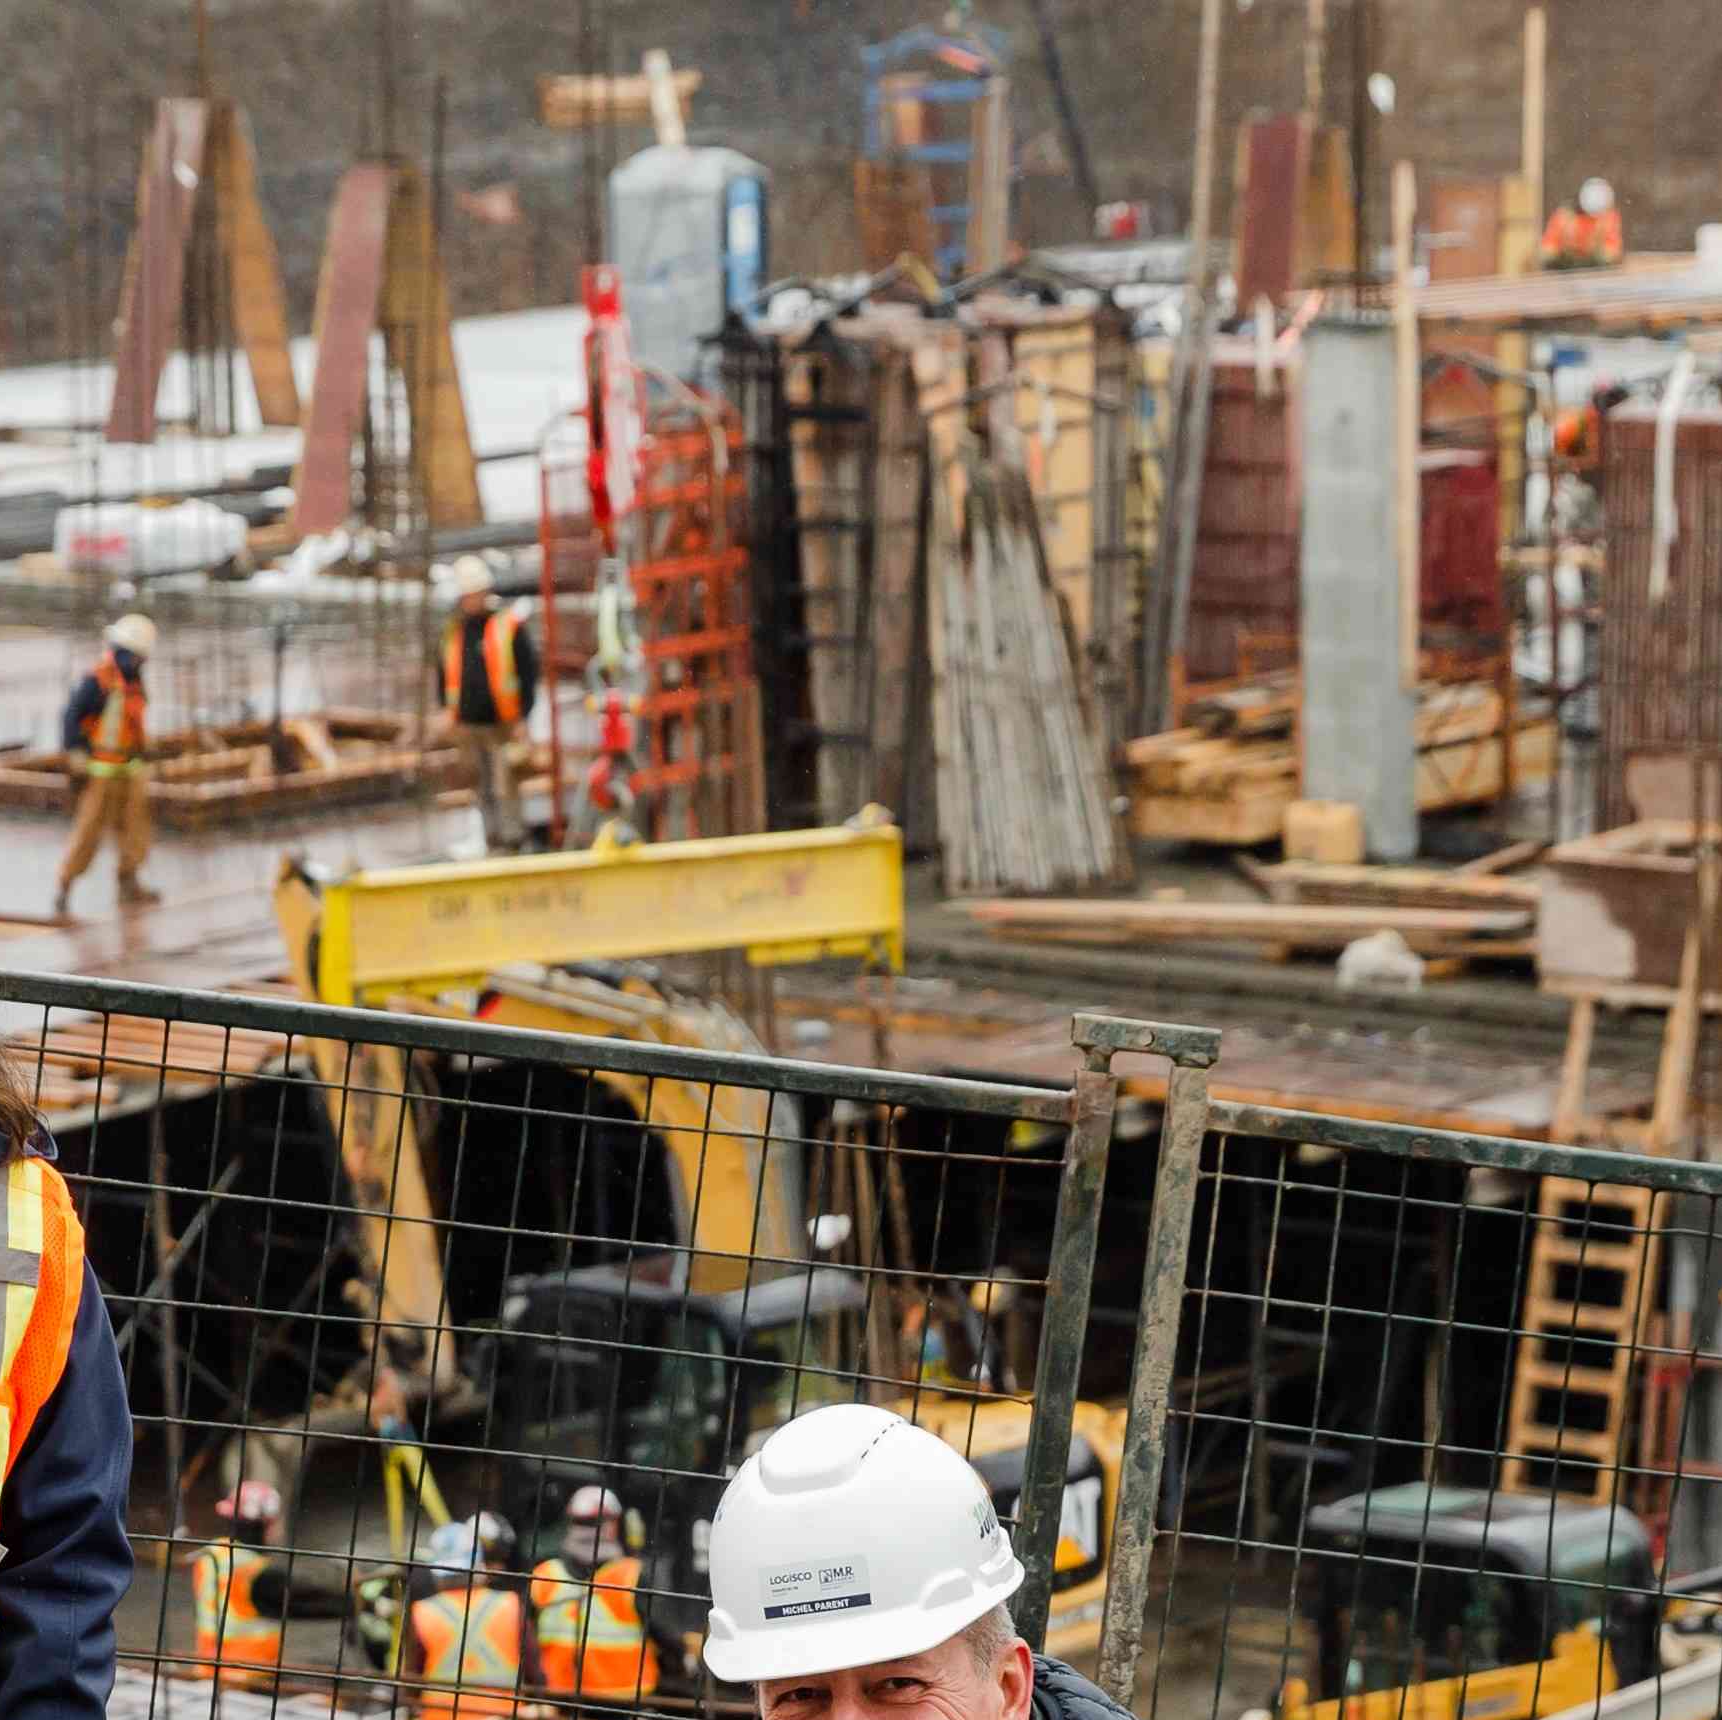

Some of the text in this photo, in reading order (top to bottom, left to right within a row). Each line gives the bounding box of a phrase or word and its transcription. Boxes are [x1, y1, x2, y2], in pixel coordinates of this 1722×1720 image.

[769, 1571, 813, 1585] LOGISCO
[782, 1598, 850, 1616] MICHEL PARENT
